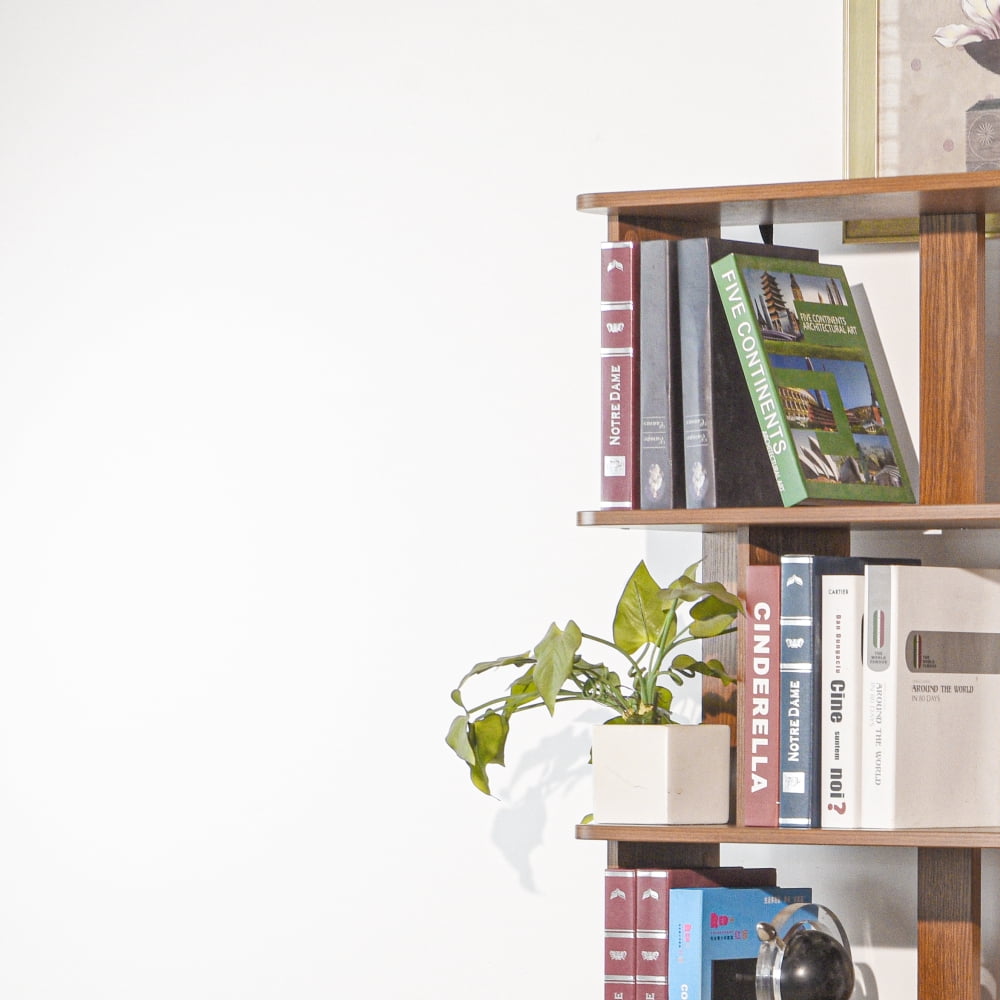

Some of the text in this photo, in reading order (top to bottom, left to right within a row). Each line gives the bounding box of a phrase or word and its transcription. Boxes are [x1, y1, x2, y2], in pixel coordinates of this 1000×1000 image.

[799, 312, 847, 326] FIVE CONTINENTS
[802, 322, 858, 335] ARCHITECTURAL ART
[721, 269, 786, 456] FIVE CONTINENTS
[609, 365, 621, 400] DAME
[609, 402, 621, 446] NOTRE
[751, 602, 771, 793] CINDERELLA
[787, 680, 800, 715] DAME
[830, 679, 846, 724] Cine
[875, 682, 883, 724] AROUND
[912, 684, 974, 694] AROUND THE WORLD
[787, 716, 800, 762] NOTRE
[874, 751, 882, 786] WORLD
